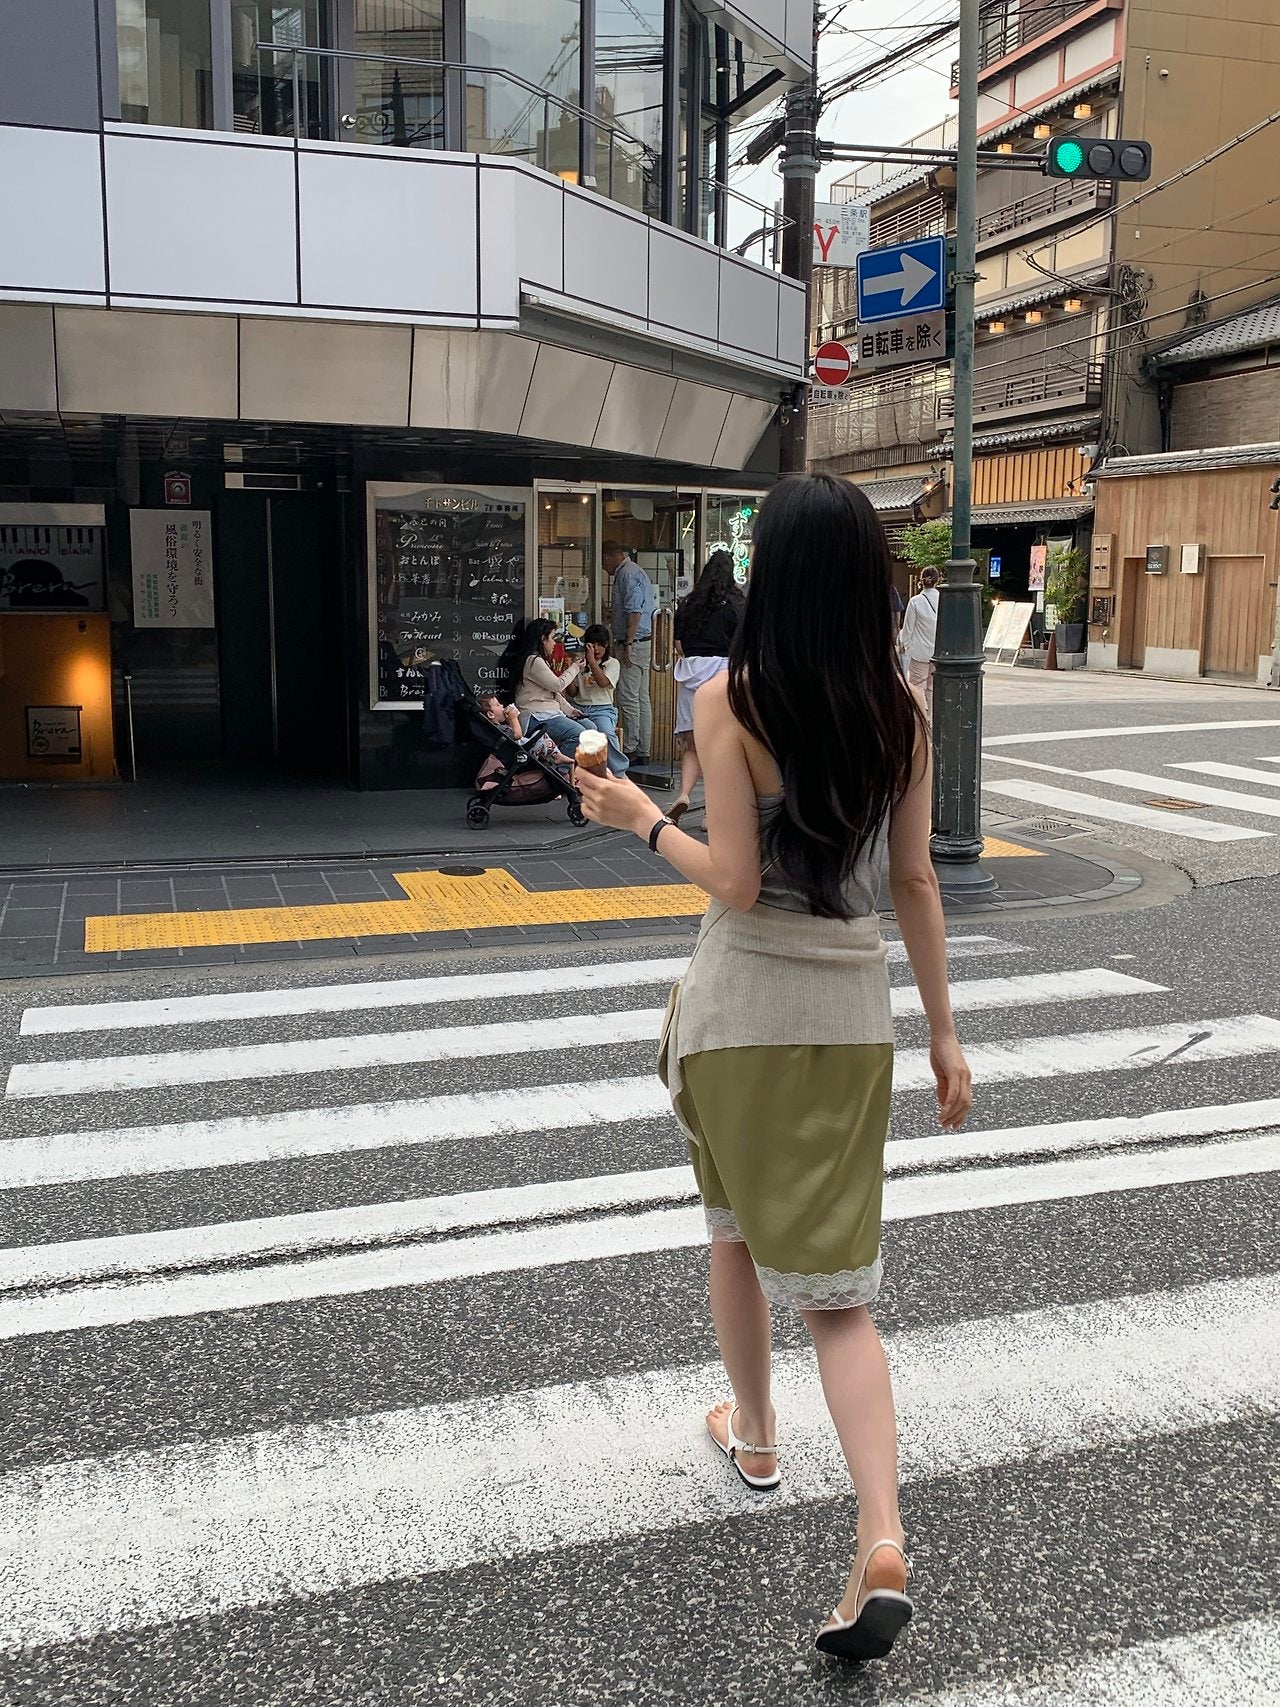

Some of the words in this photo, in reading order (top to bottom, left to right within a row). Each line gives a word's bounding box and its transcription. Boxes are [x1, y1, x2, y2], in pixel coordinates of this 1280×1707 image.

[841, 207, 868, 219] 三条駅
[861, 323, 941, 359] 自転車を除く
[814, 389, 848, 401] 自転車を除く
[425, 497, 480, 511] モトサンビル
[192, 520, 203, 586] 明るく安全な街
[165, 524, 178, 618] 風俗環境を守ろう
